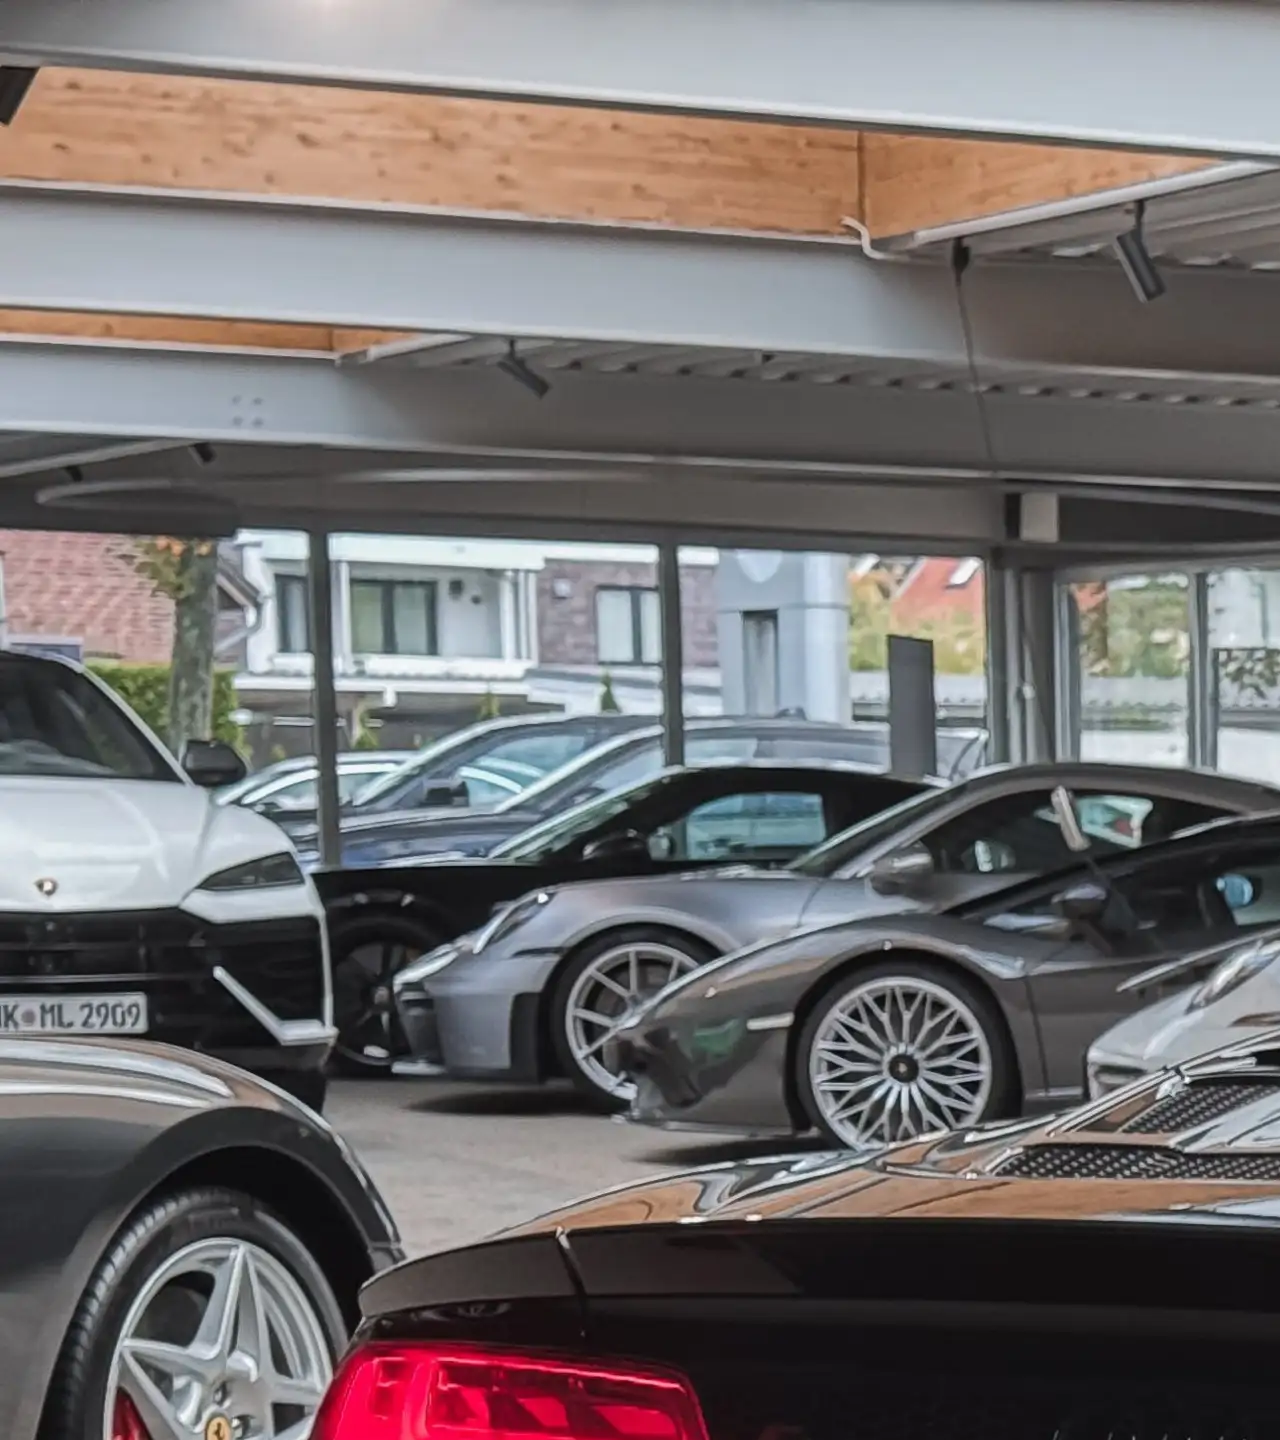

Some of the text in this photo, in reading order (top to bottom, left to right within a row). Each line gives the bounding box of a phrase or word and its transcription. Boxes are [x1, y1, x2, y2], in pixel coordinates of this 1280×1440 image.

[0, 1002, 141, 1029] K ML 2909
